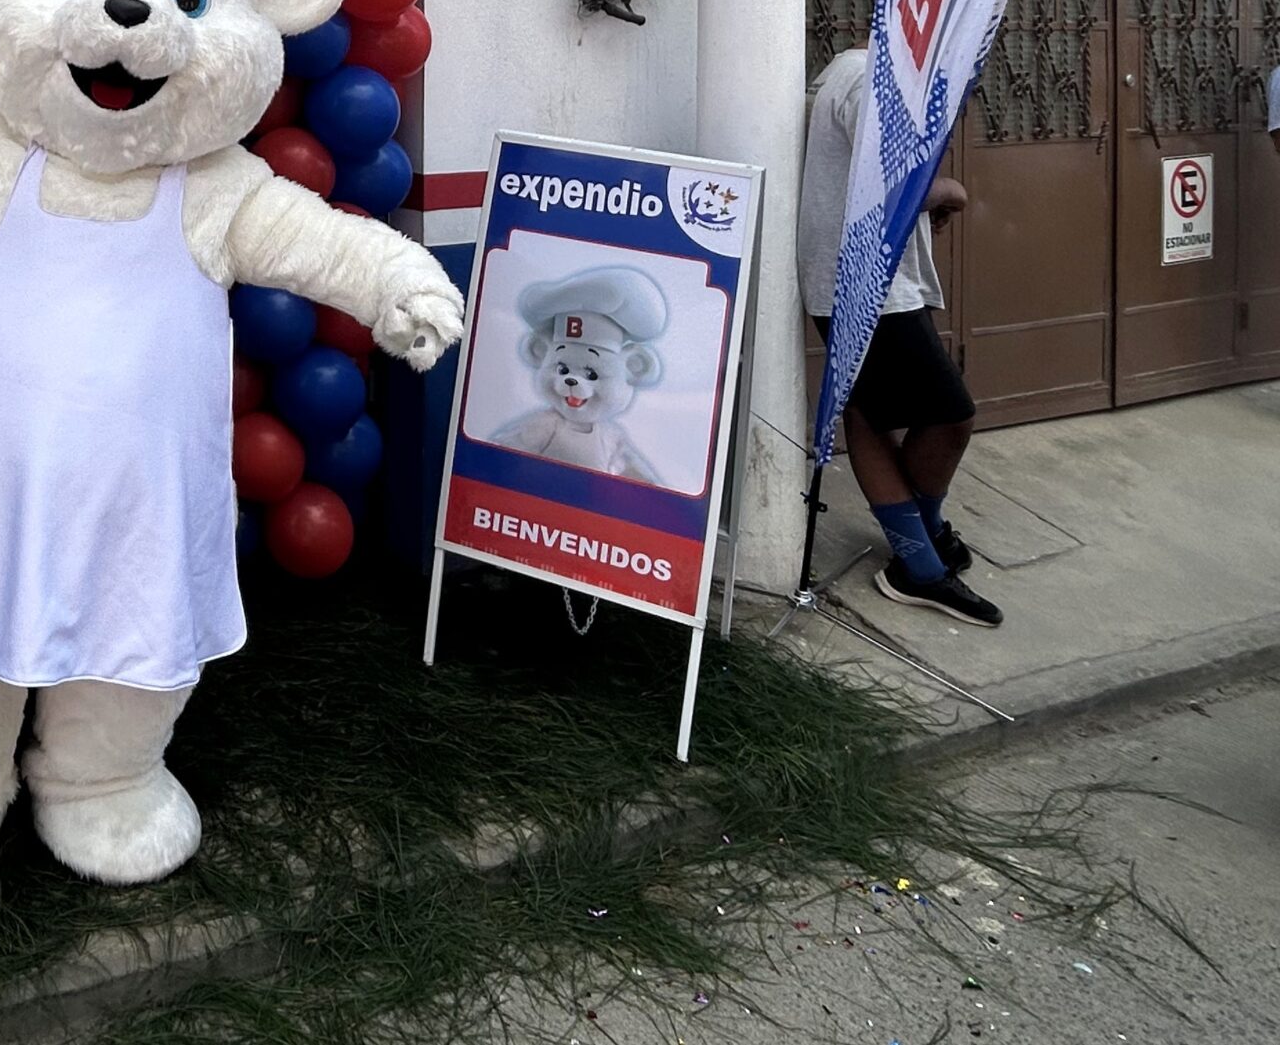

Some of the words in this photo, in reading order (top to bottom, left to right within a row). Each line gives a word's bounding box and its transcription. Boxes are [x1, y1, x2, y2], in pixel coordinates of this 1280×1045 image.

[500, 171, 663, 218] expendio
[1183, 222, 1193, 233] NO
[1165, 232, 1211, 249] ESTACIONAR
[565, 316, 583, 338] B
[473, 506, 672, 582] BIENVENIDOS
